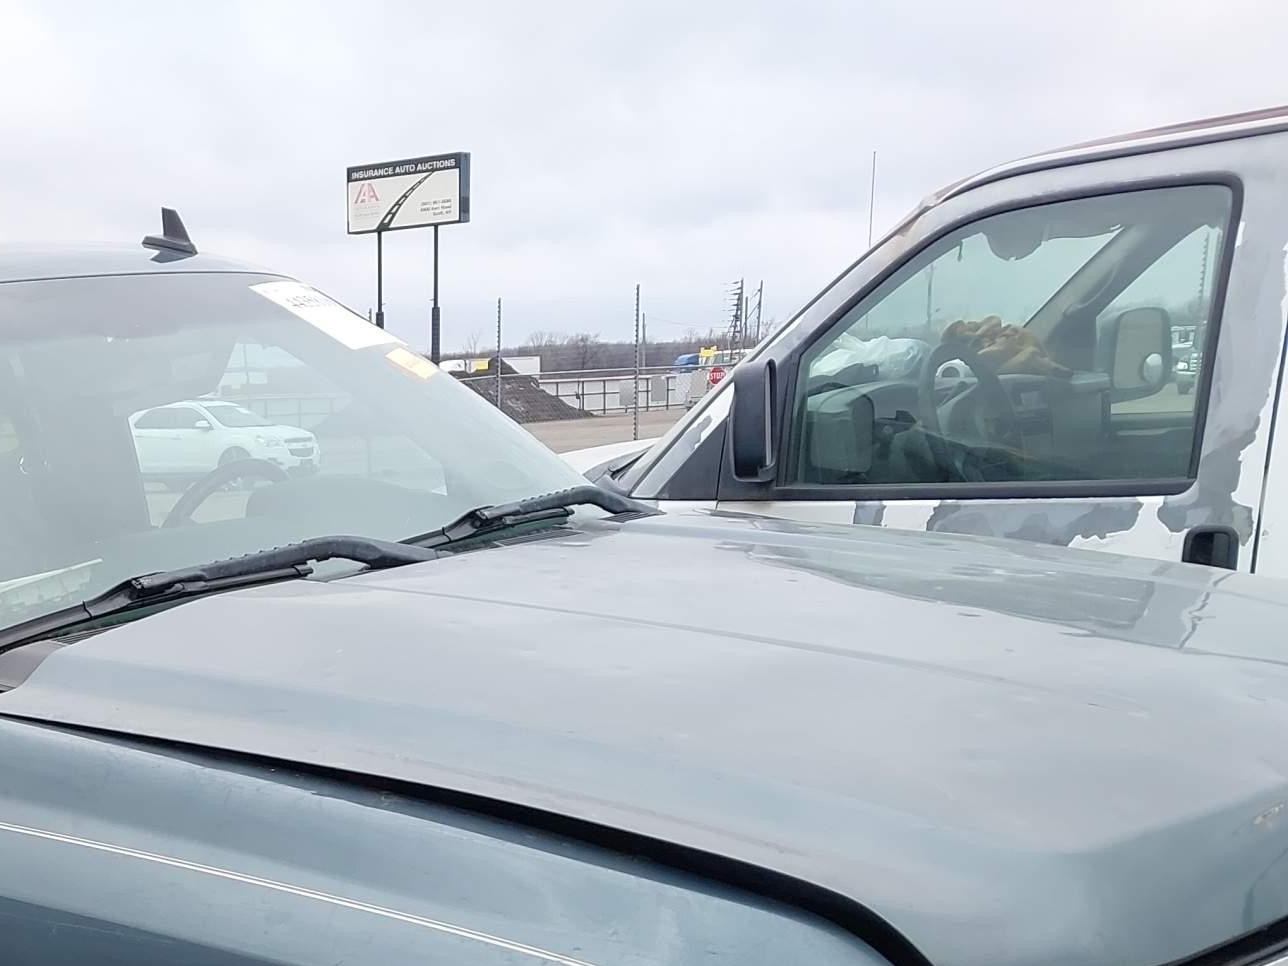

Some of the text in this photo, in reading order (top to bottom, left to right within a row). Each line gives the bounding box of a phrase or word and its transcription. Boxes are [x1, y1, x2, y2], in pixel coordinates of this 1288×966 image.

[351, 158, 455, 179] INSURANCE AUTO AUCTIONS
